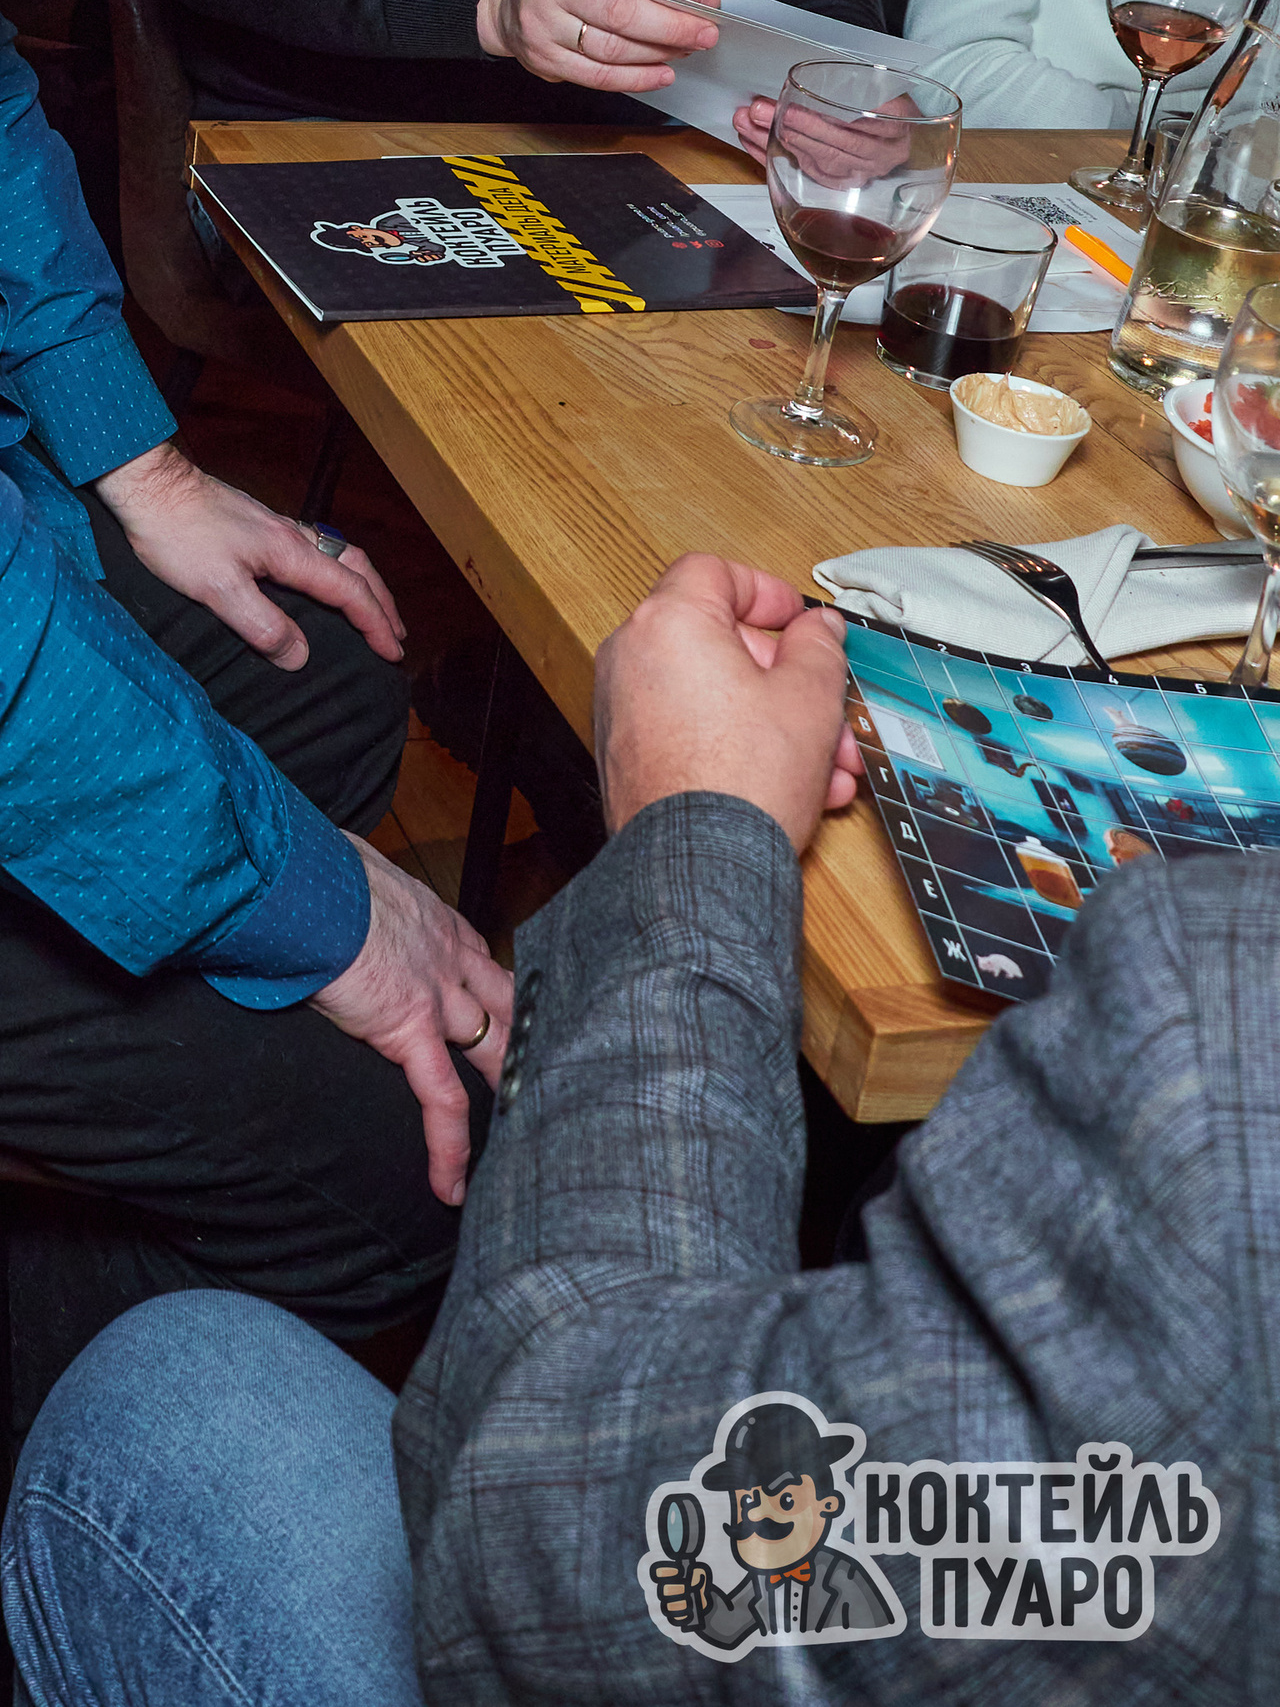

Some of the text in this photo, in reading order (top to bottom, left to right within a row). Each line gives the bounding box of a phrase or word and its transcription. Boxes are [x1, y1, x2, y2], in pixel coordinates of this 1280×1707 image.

[407, 201, 498, 266] КОКТЕЙЛЬ
[452, 211, 521, 252] ПУАРО
[488, 187, 592, 274] МАТЕРИАЛЫ ДЕЛА
[938, 642, 950, 654] 2
[1021, 662, 1031, 674] 3
[1108, 674, 1119, 686] 4
[1195, 683, 1207, 695] 5
[878, 767, 889, 782] Г
[900, 821, 918, 842] Д
[943, 938, 967, 962] Ж
